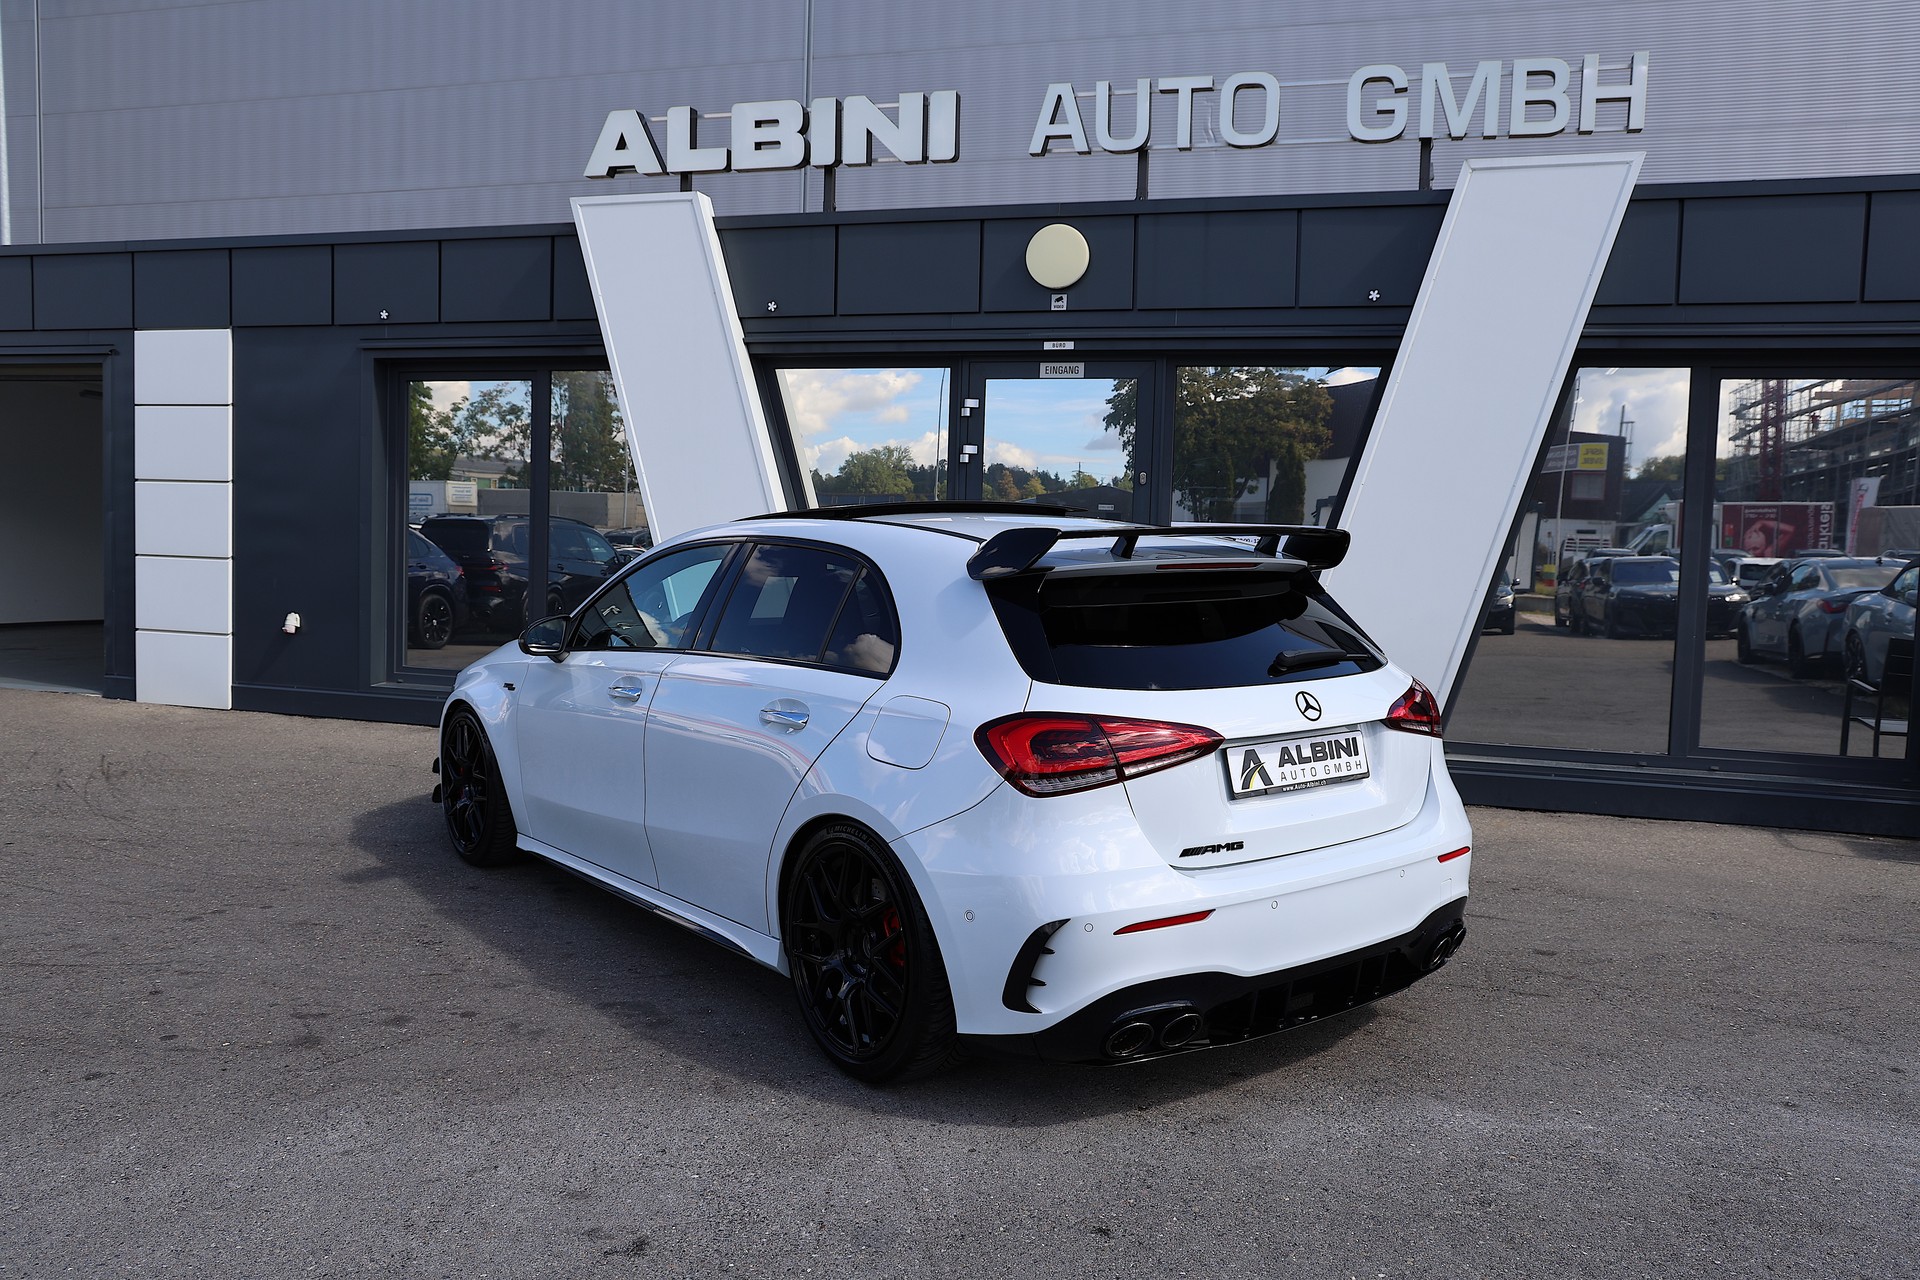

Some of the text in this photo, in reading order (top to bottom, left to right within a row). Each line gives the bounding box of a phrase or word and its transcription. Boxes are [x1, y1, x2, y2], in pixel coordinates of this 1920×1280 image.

[584, 50, 1650, 179] ALBINI AUTO GMBH
[1045, 365, 1080, 375] EINGANG
[1278, 736, 1360, 768] ALBINI
[1280, 759, 1363, 782] AUTO GMBH
[1199, 840, 1244, 856] AMG
